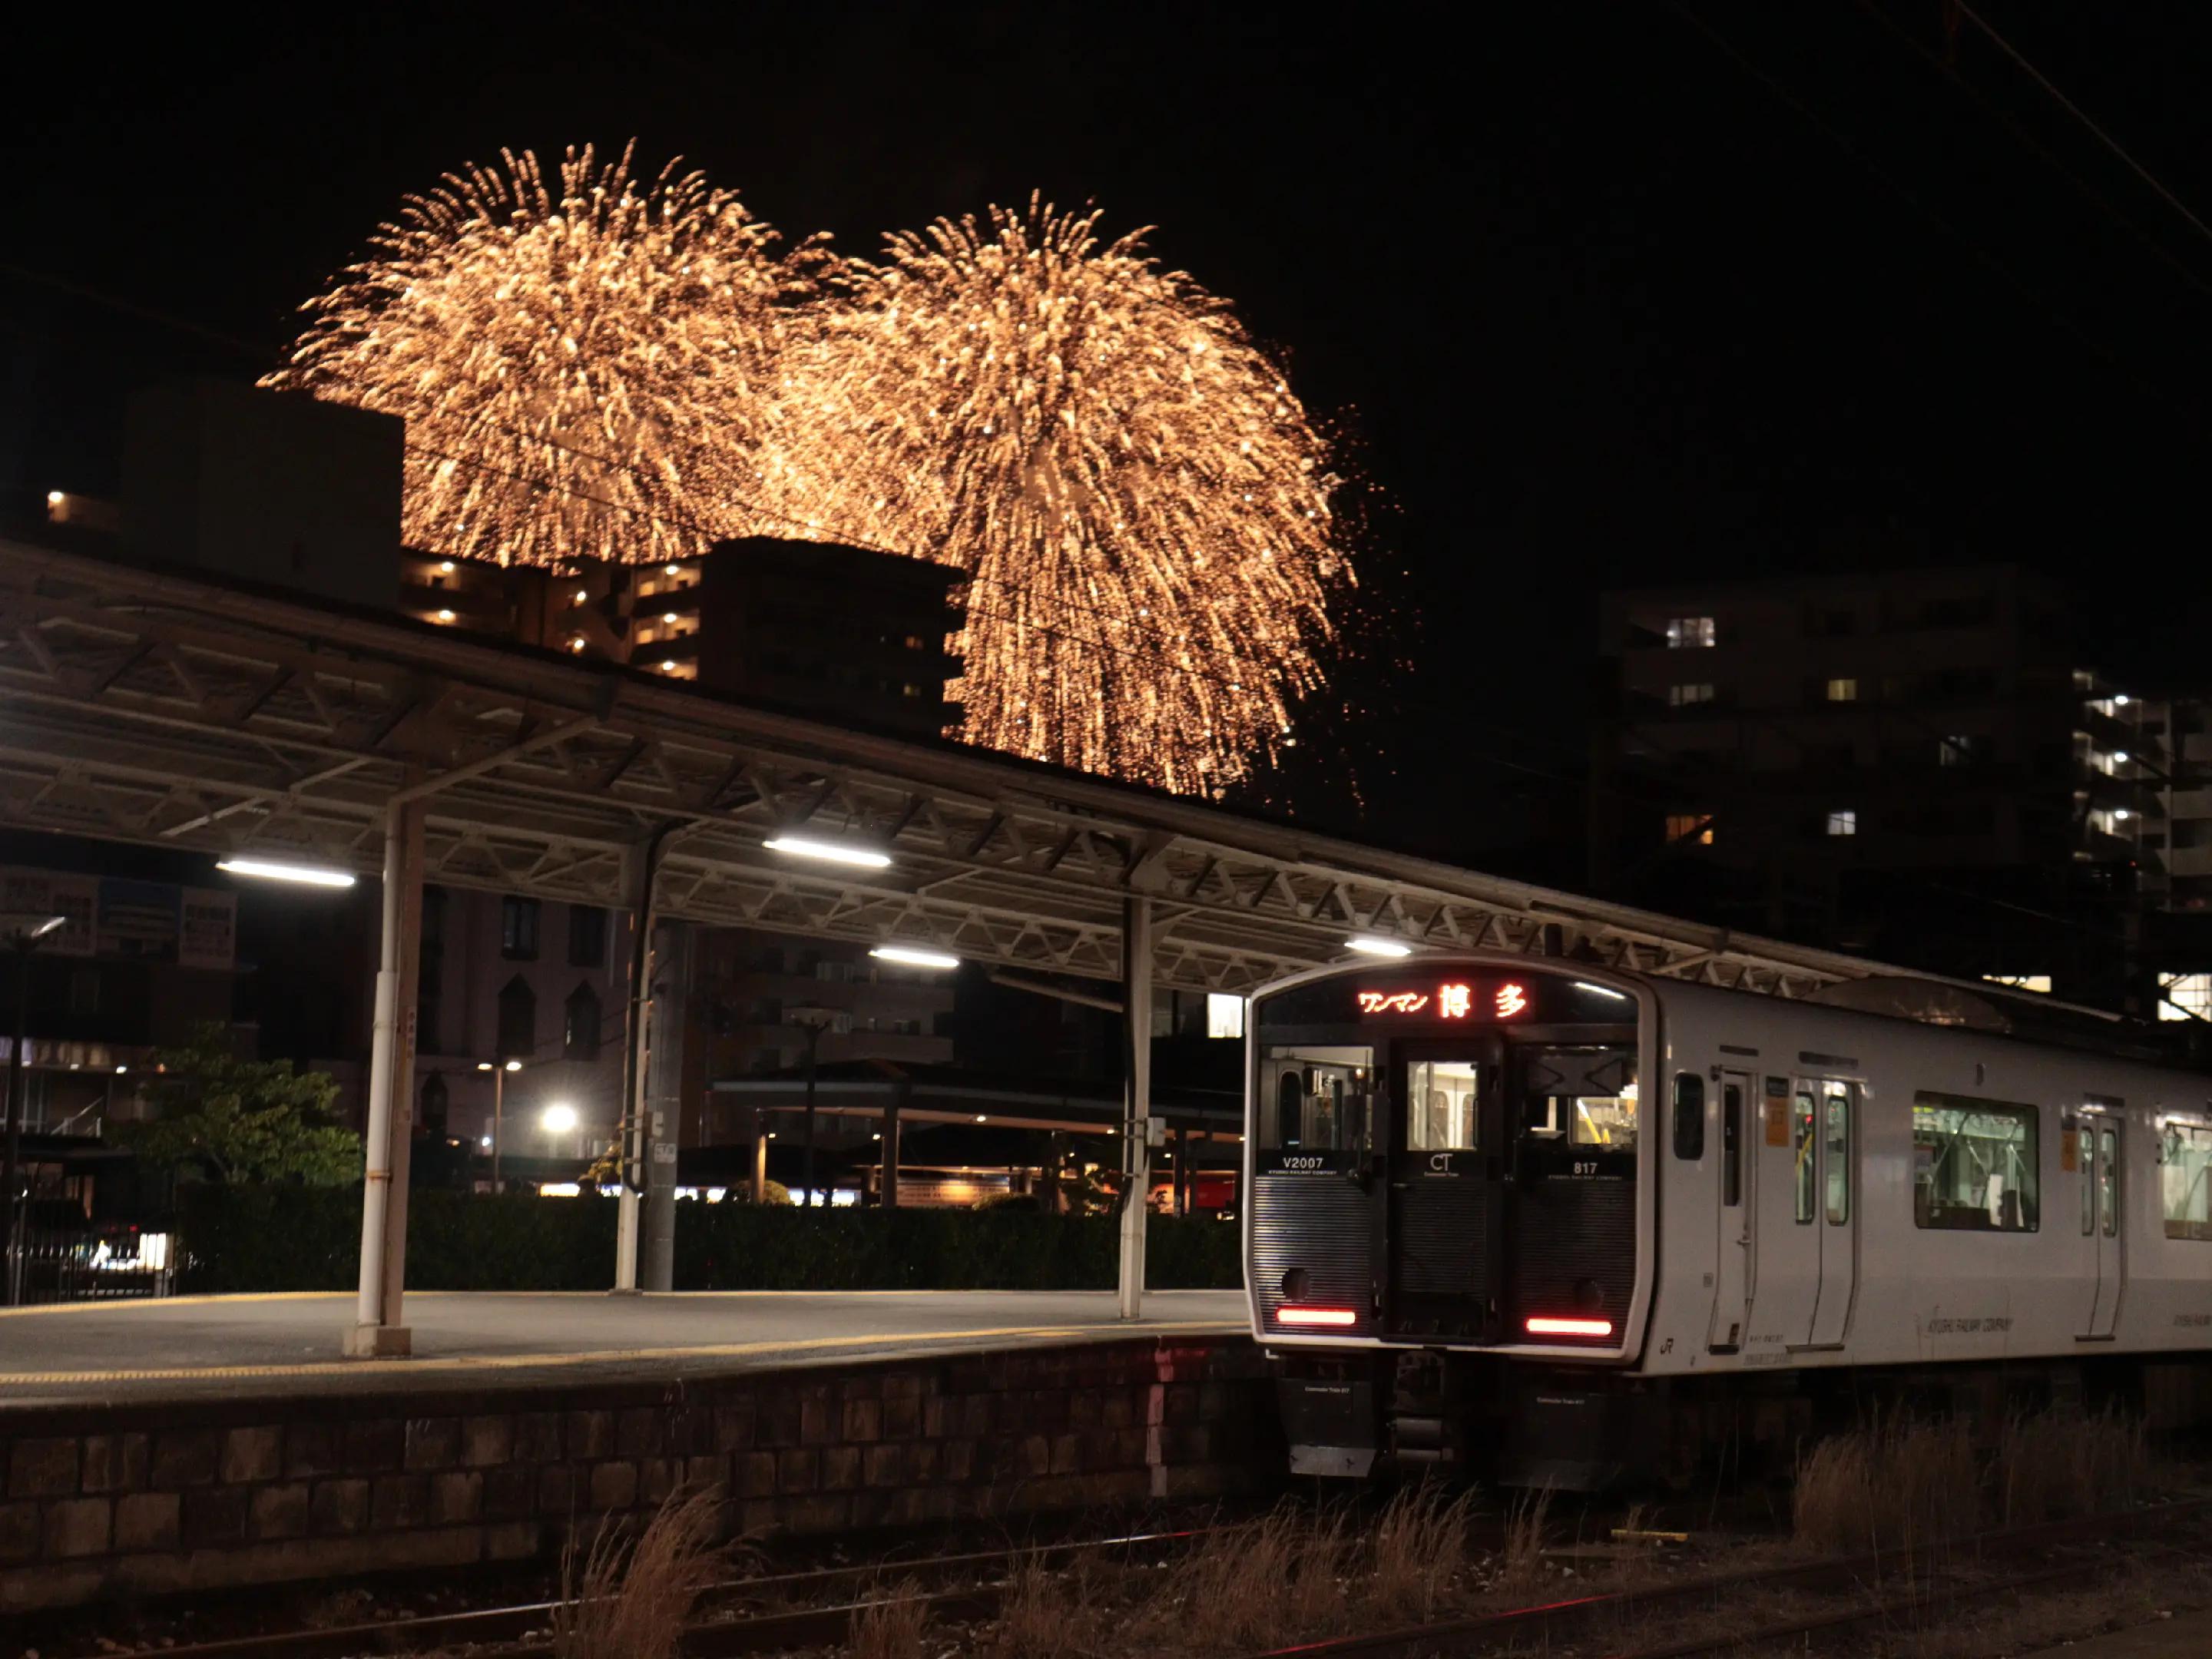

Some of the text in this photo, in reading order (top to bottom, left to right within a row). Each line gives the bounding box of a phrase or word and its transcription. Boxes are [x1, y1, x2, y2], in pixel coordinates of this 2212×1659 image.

[1358, 984, 1527, 1018] ワンマン 博多
[1282, 1157, 1324, 1168] V2007
[1429, 1153, 1454, 1171] CT
[1573, 1161, 1598, 1174] 817
